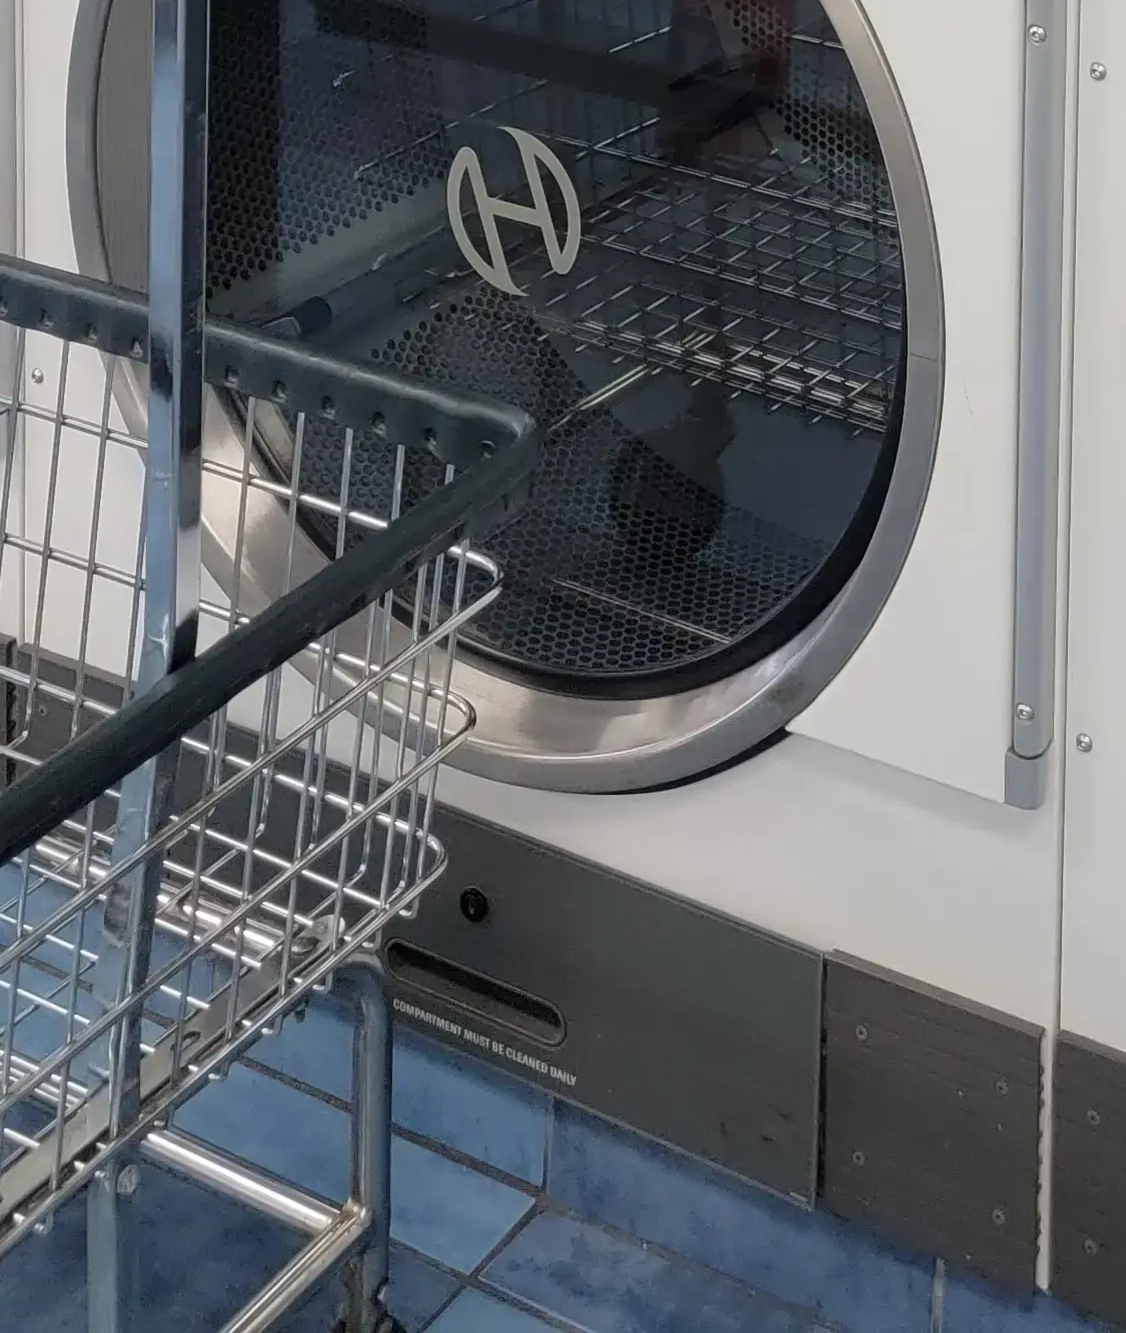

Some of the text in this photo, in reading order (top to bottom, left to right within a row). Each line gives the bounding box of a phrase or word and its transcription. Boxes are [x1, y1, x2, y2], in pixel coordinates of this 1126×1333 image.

[392, 997, 578, 1086] COMPARTMENT MUST BE CLEANED DAILY
